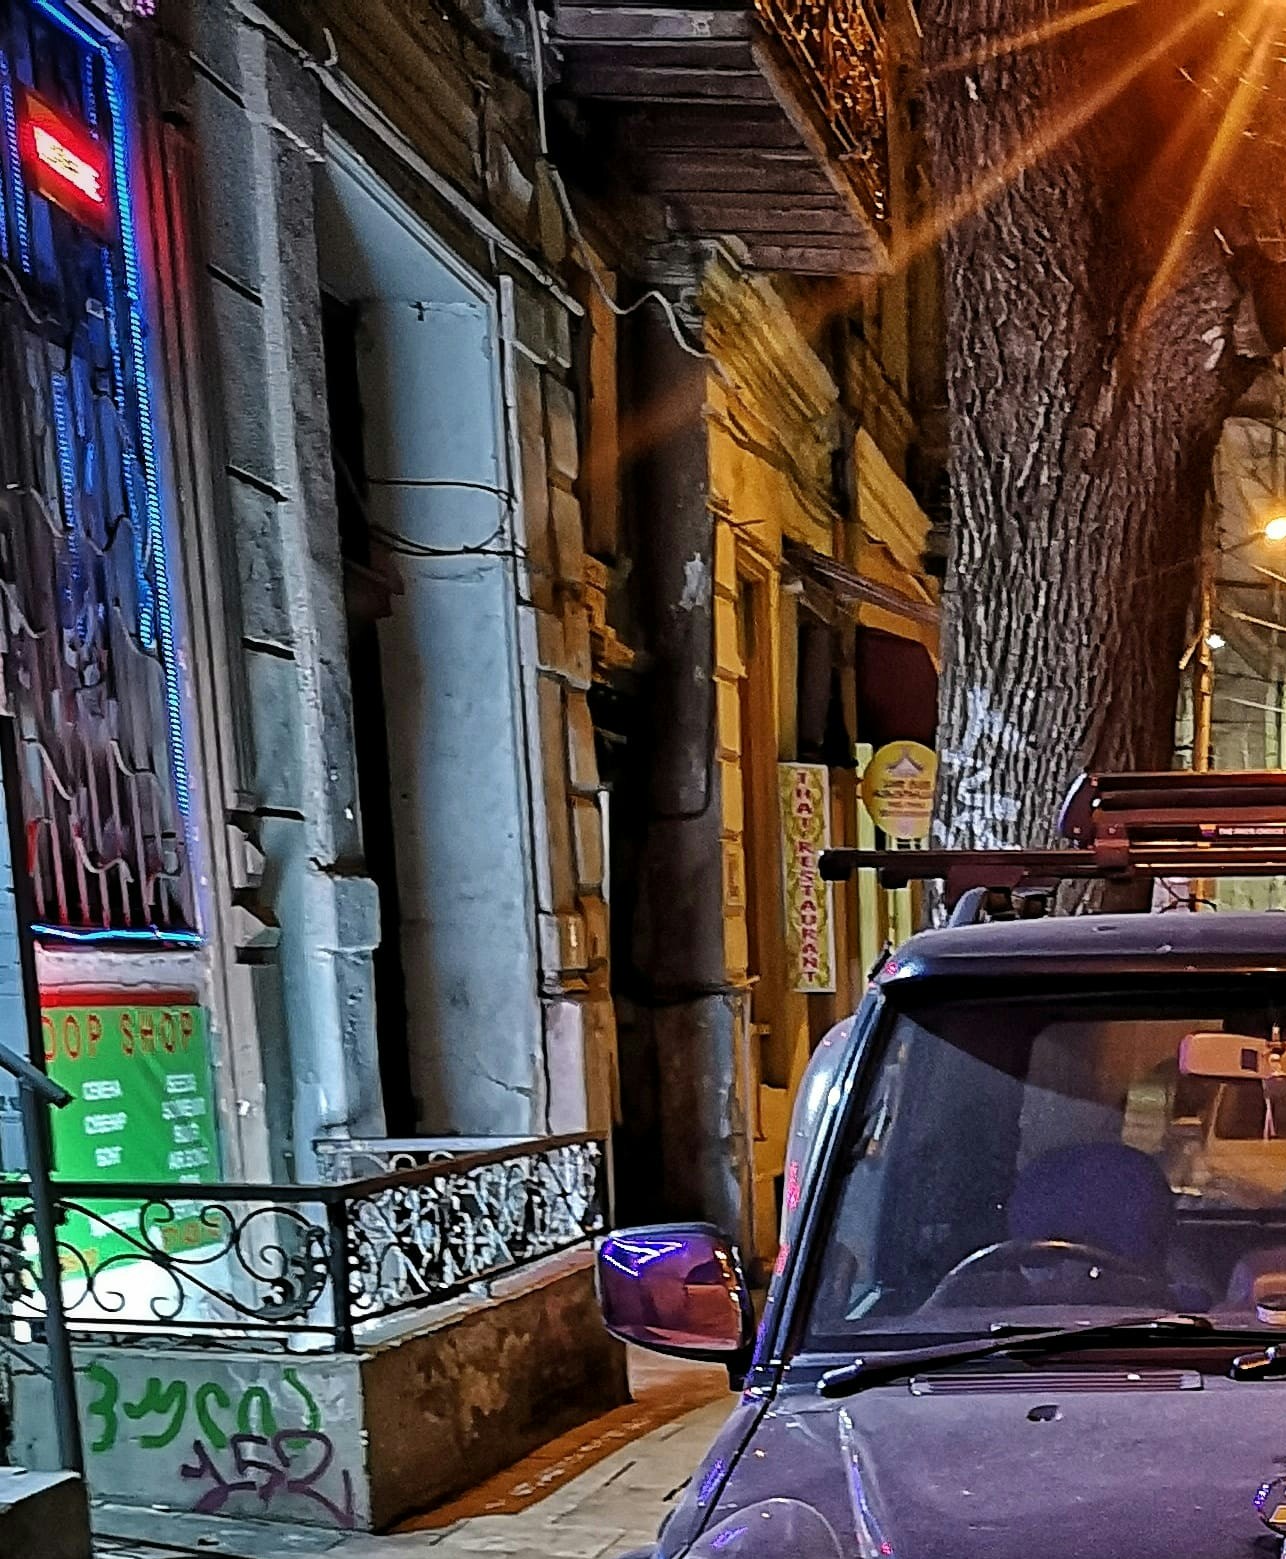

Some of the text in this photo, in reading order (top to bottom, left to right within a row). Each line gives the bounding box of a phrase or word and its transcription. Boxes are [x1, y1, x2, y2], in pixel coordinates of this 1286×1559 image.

[795, 771, 819, 983] THAI RESTAURANT
[119, 1010, 193, 1058] SHOP
